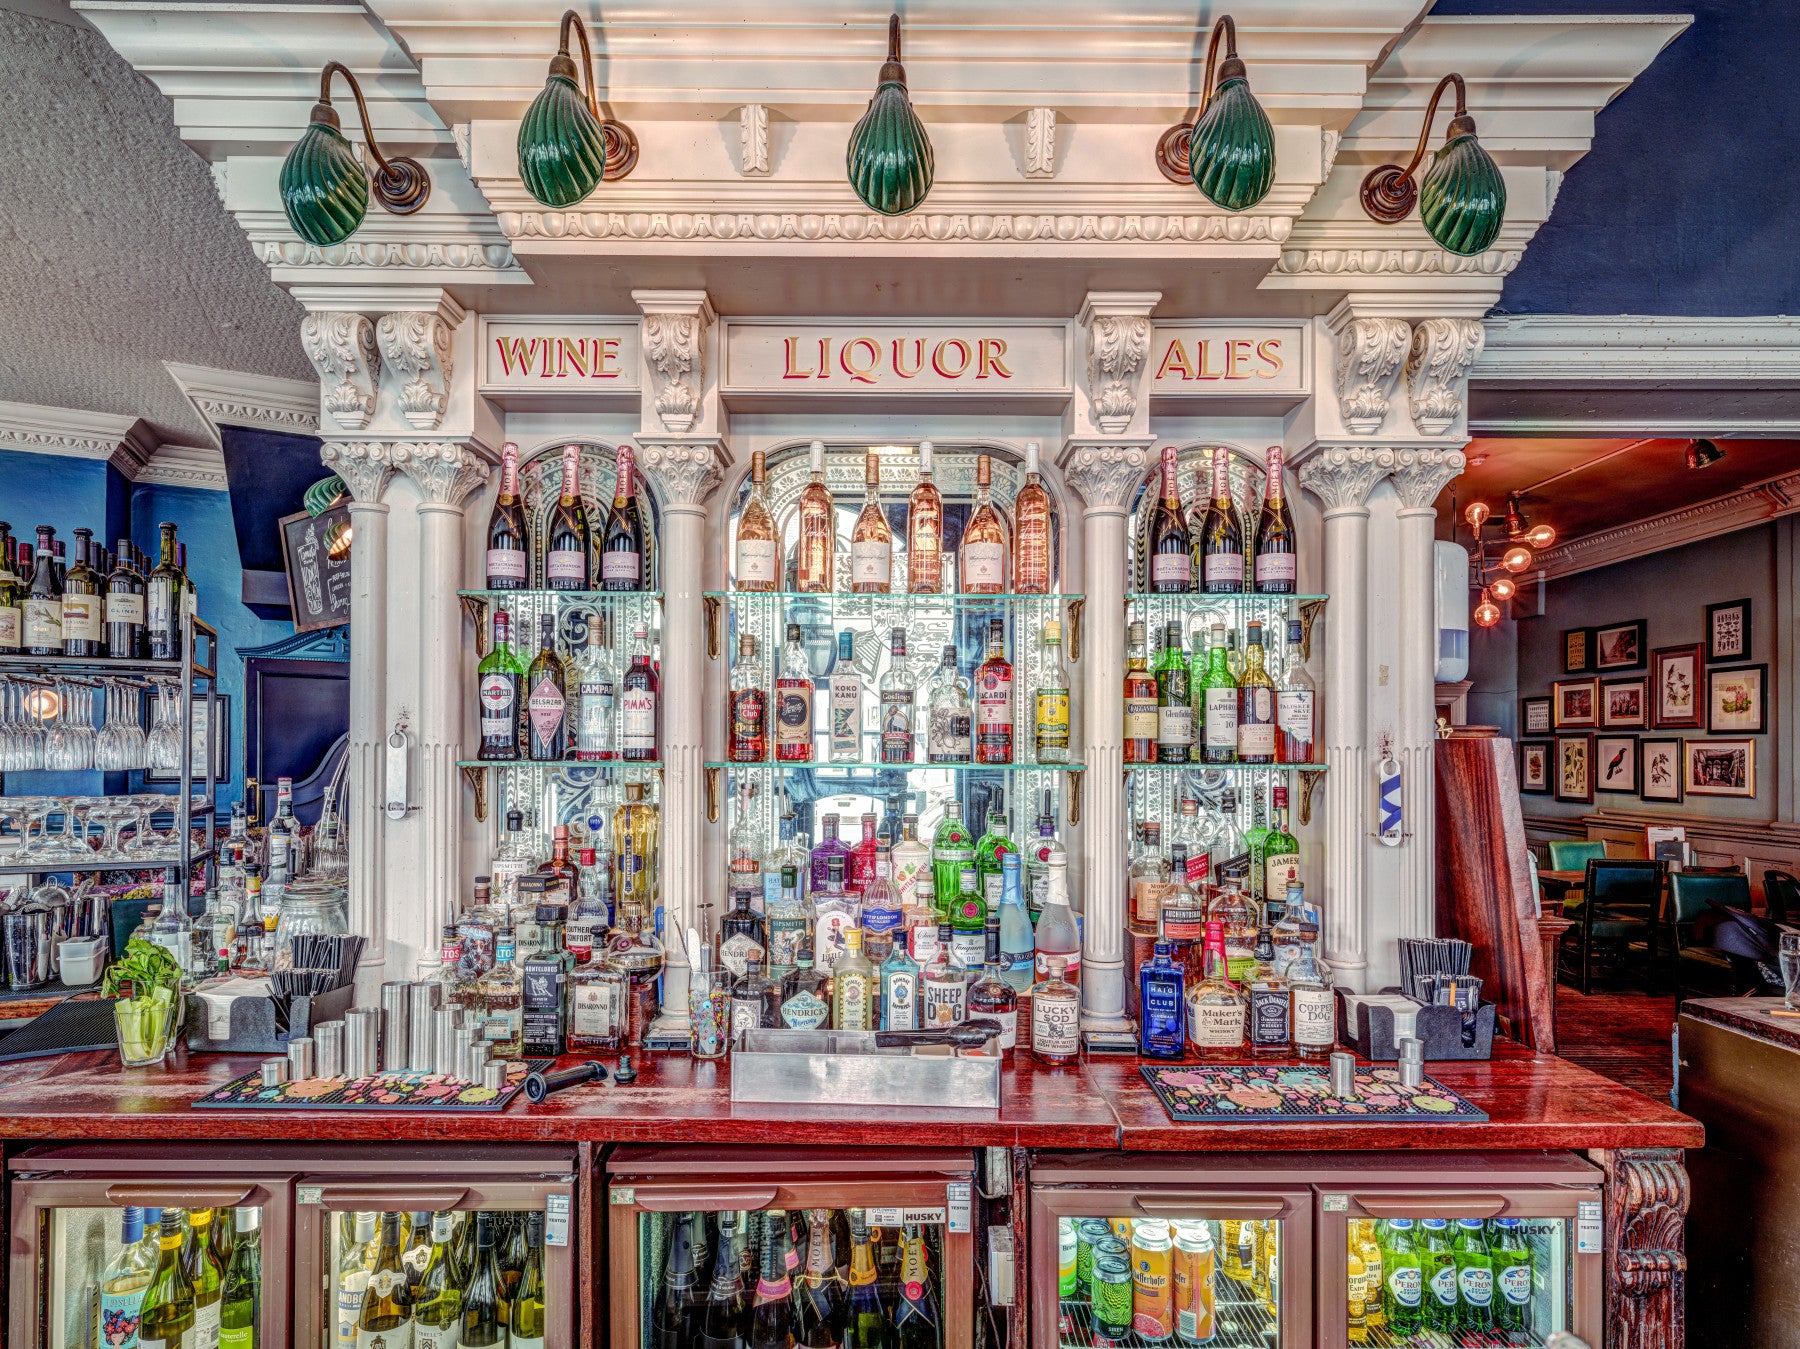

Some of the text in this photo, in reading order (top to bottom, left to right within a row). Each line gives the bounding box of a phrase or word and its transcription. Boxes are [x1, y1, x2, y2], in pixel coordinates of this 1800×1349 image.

[496, 336, 622, 378] WINE
[783, 336, 1014, 384] LIQUOR
[1156, 338, 1284, 380] ALES
[581, 684, 612, 694] CAMPAR
[624, 698, 652, 710] PIMM'S
[1272, 857, 1299, 867] JAMES
[442, 950, 459, 958] LTOS
[496, 949, 514, 957] LTOS
[928, 987, 962, 1003] SHEEP
[782, 1008, 827, 1016] HENDRICK'S
[1037, 1005, 1076, 1015] LUCKY
[1308, 1012, 1331, 1020] DOG
[1186, 1084, 1422, 1096] BEAVERTWN
[486, 1217, 531, 1227] HUSKY
[1509, 1226, 1555, 1234] HUSKY
[1395, 1279, 1421, 1288] PERON
[1463, 1278, 1492, 1288] PERON
[1505, 1278, 1529, 1286] PERO
[339, 1292, 364, 1303] ANDBO
